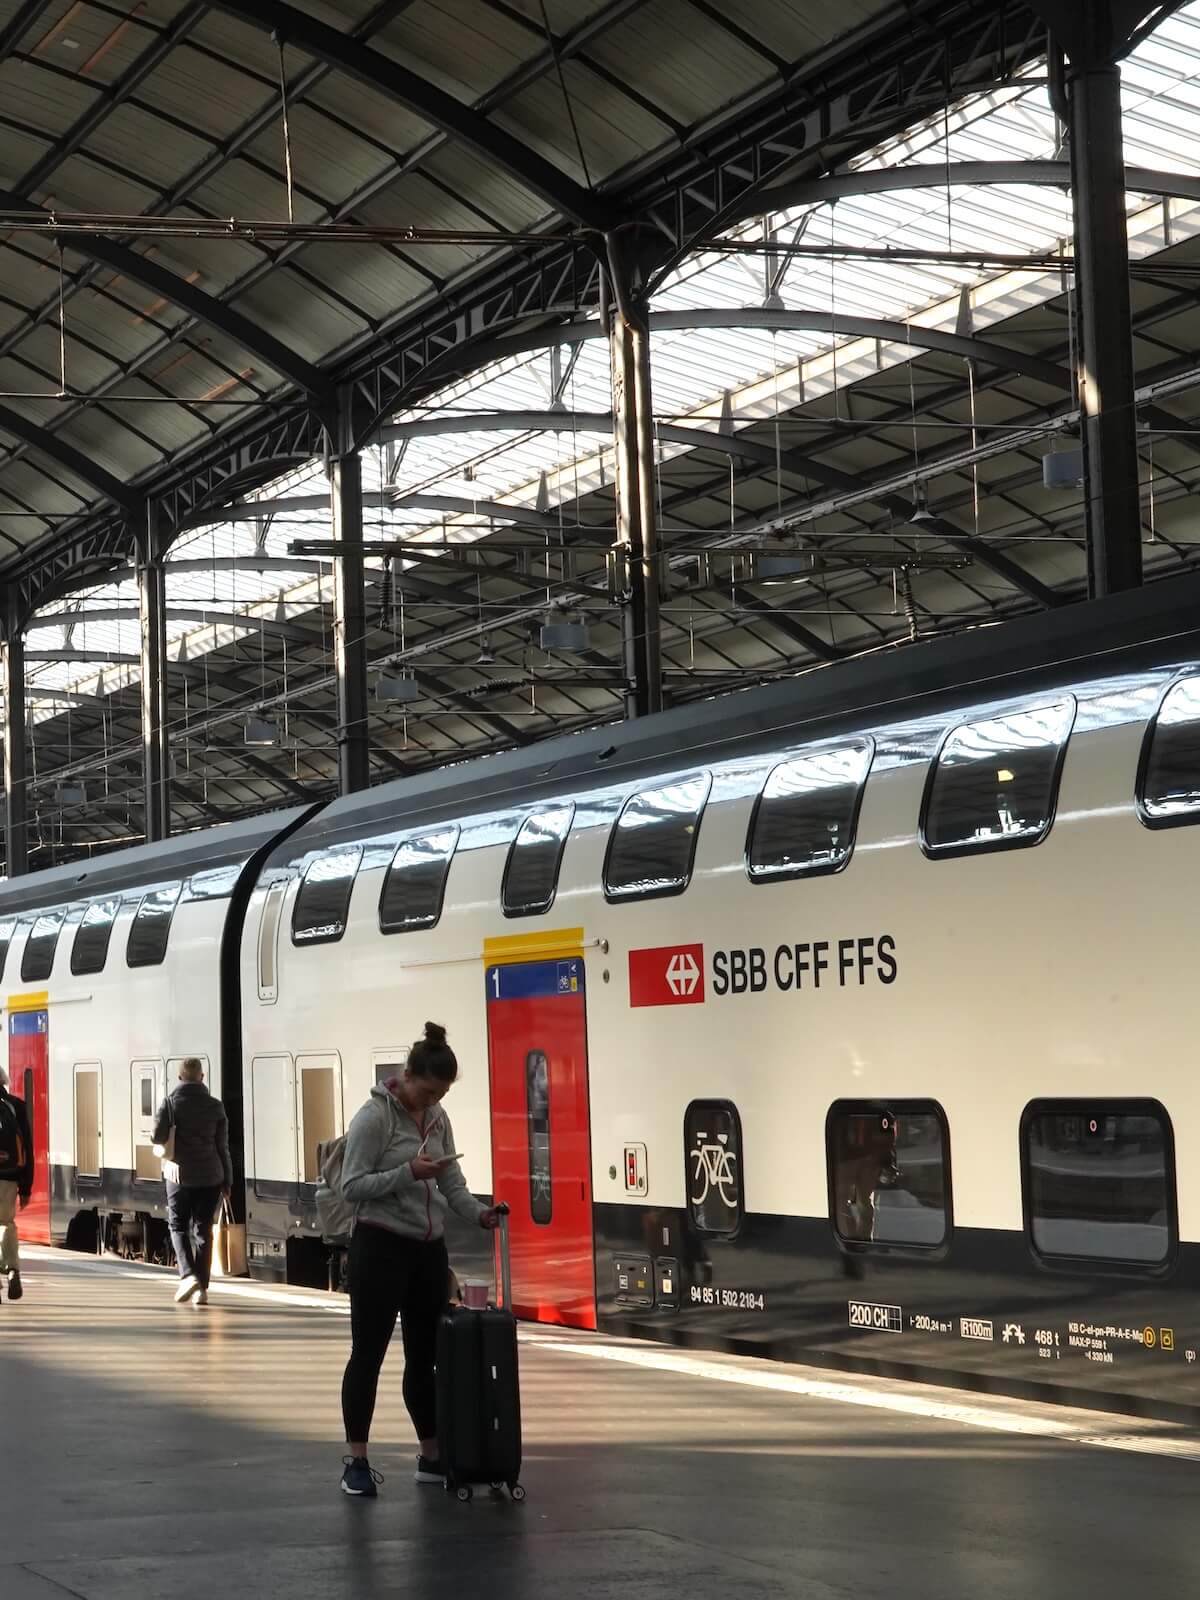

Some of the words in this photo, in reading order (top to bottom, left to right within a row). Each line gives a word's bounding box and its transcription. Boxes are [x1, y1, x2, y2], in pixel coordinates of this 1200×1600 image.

[712, 948, 767, 996] SBB
[774, 941, 830, 991] CFF
[839, 934, 897, 987] FFS
[492, 968, 500, 998] 1
[690, 1285, 701, 1302] 94
[703, 1287, 714, 1303] 85
[715, 1289, 720, 1304] 1
[722, 1290, 738, 1306] 502
[740, 1291, 764, 1310] 218-4
[851, 1304, 872, 1325] 200
[873, 1307, 889, 1328] CH
[961, 1321, 992, 1337] R100m
[1034, 1329, 1053, 1346] 468
